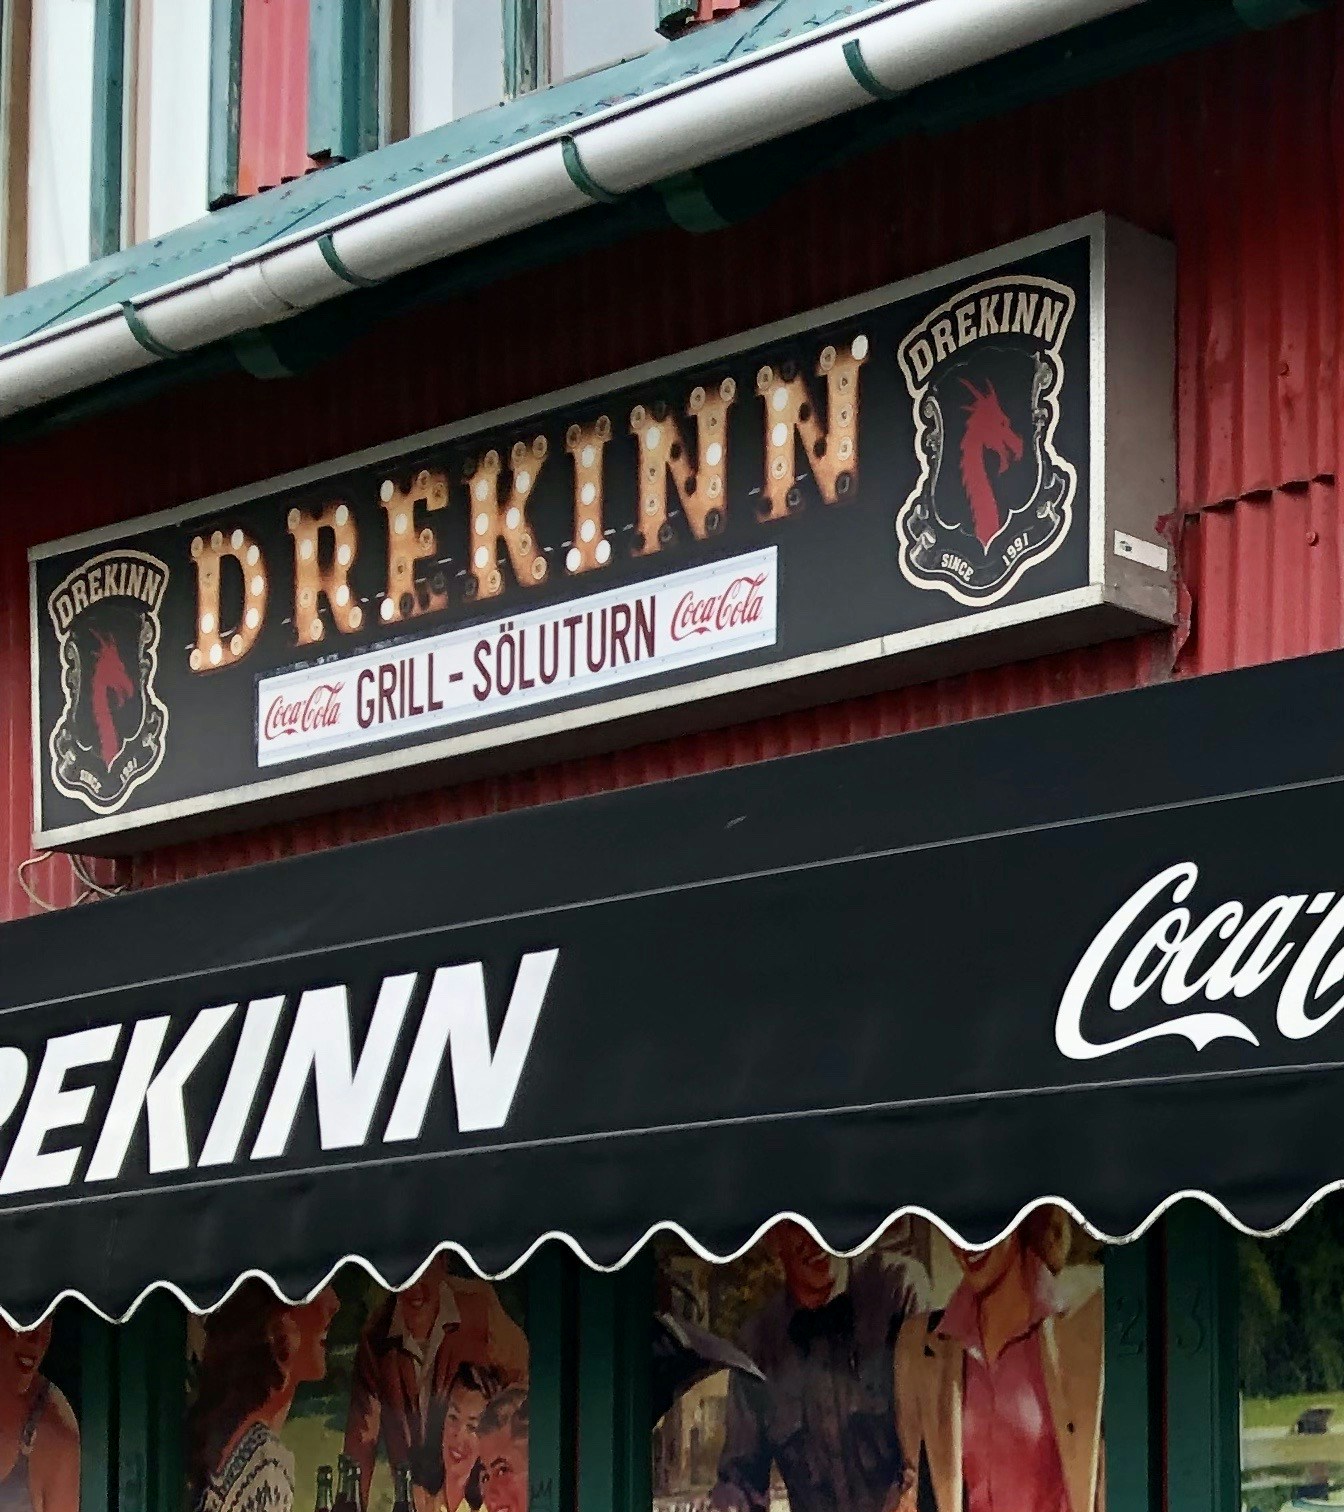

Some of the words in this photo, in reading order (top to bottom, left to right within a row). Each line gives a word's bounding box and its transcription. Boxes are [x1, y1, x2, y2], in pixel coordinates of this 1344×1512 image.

[909, 292, 1064, 381] DREKINN
[187, 334, 869, 672] DREKINN
[941, 553, 973, 582] SINCE
[1003, 533, 1029, 567] 1991
[56, 563, 161, 628] DREKINN
[265, 682, 345, 741] Coca-Cola
[670, 571, 769, 642] Coca-Cola
